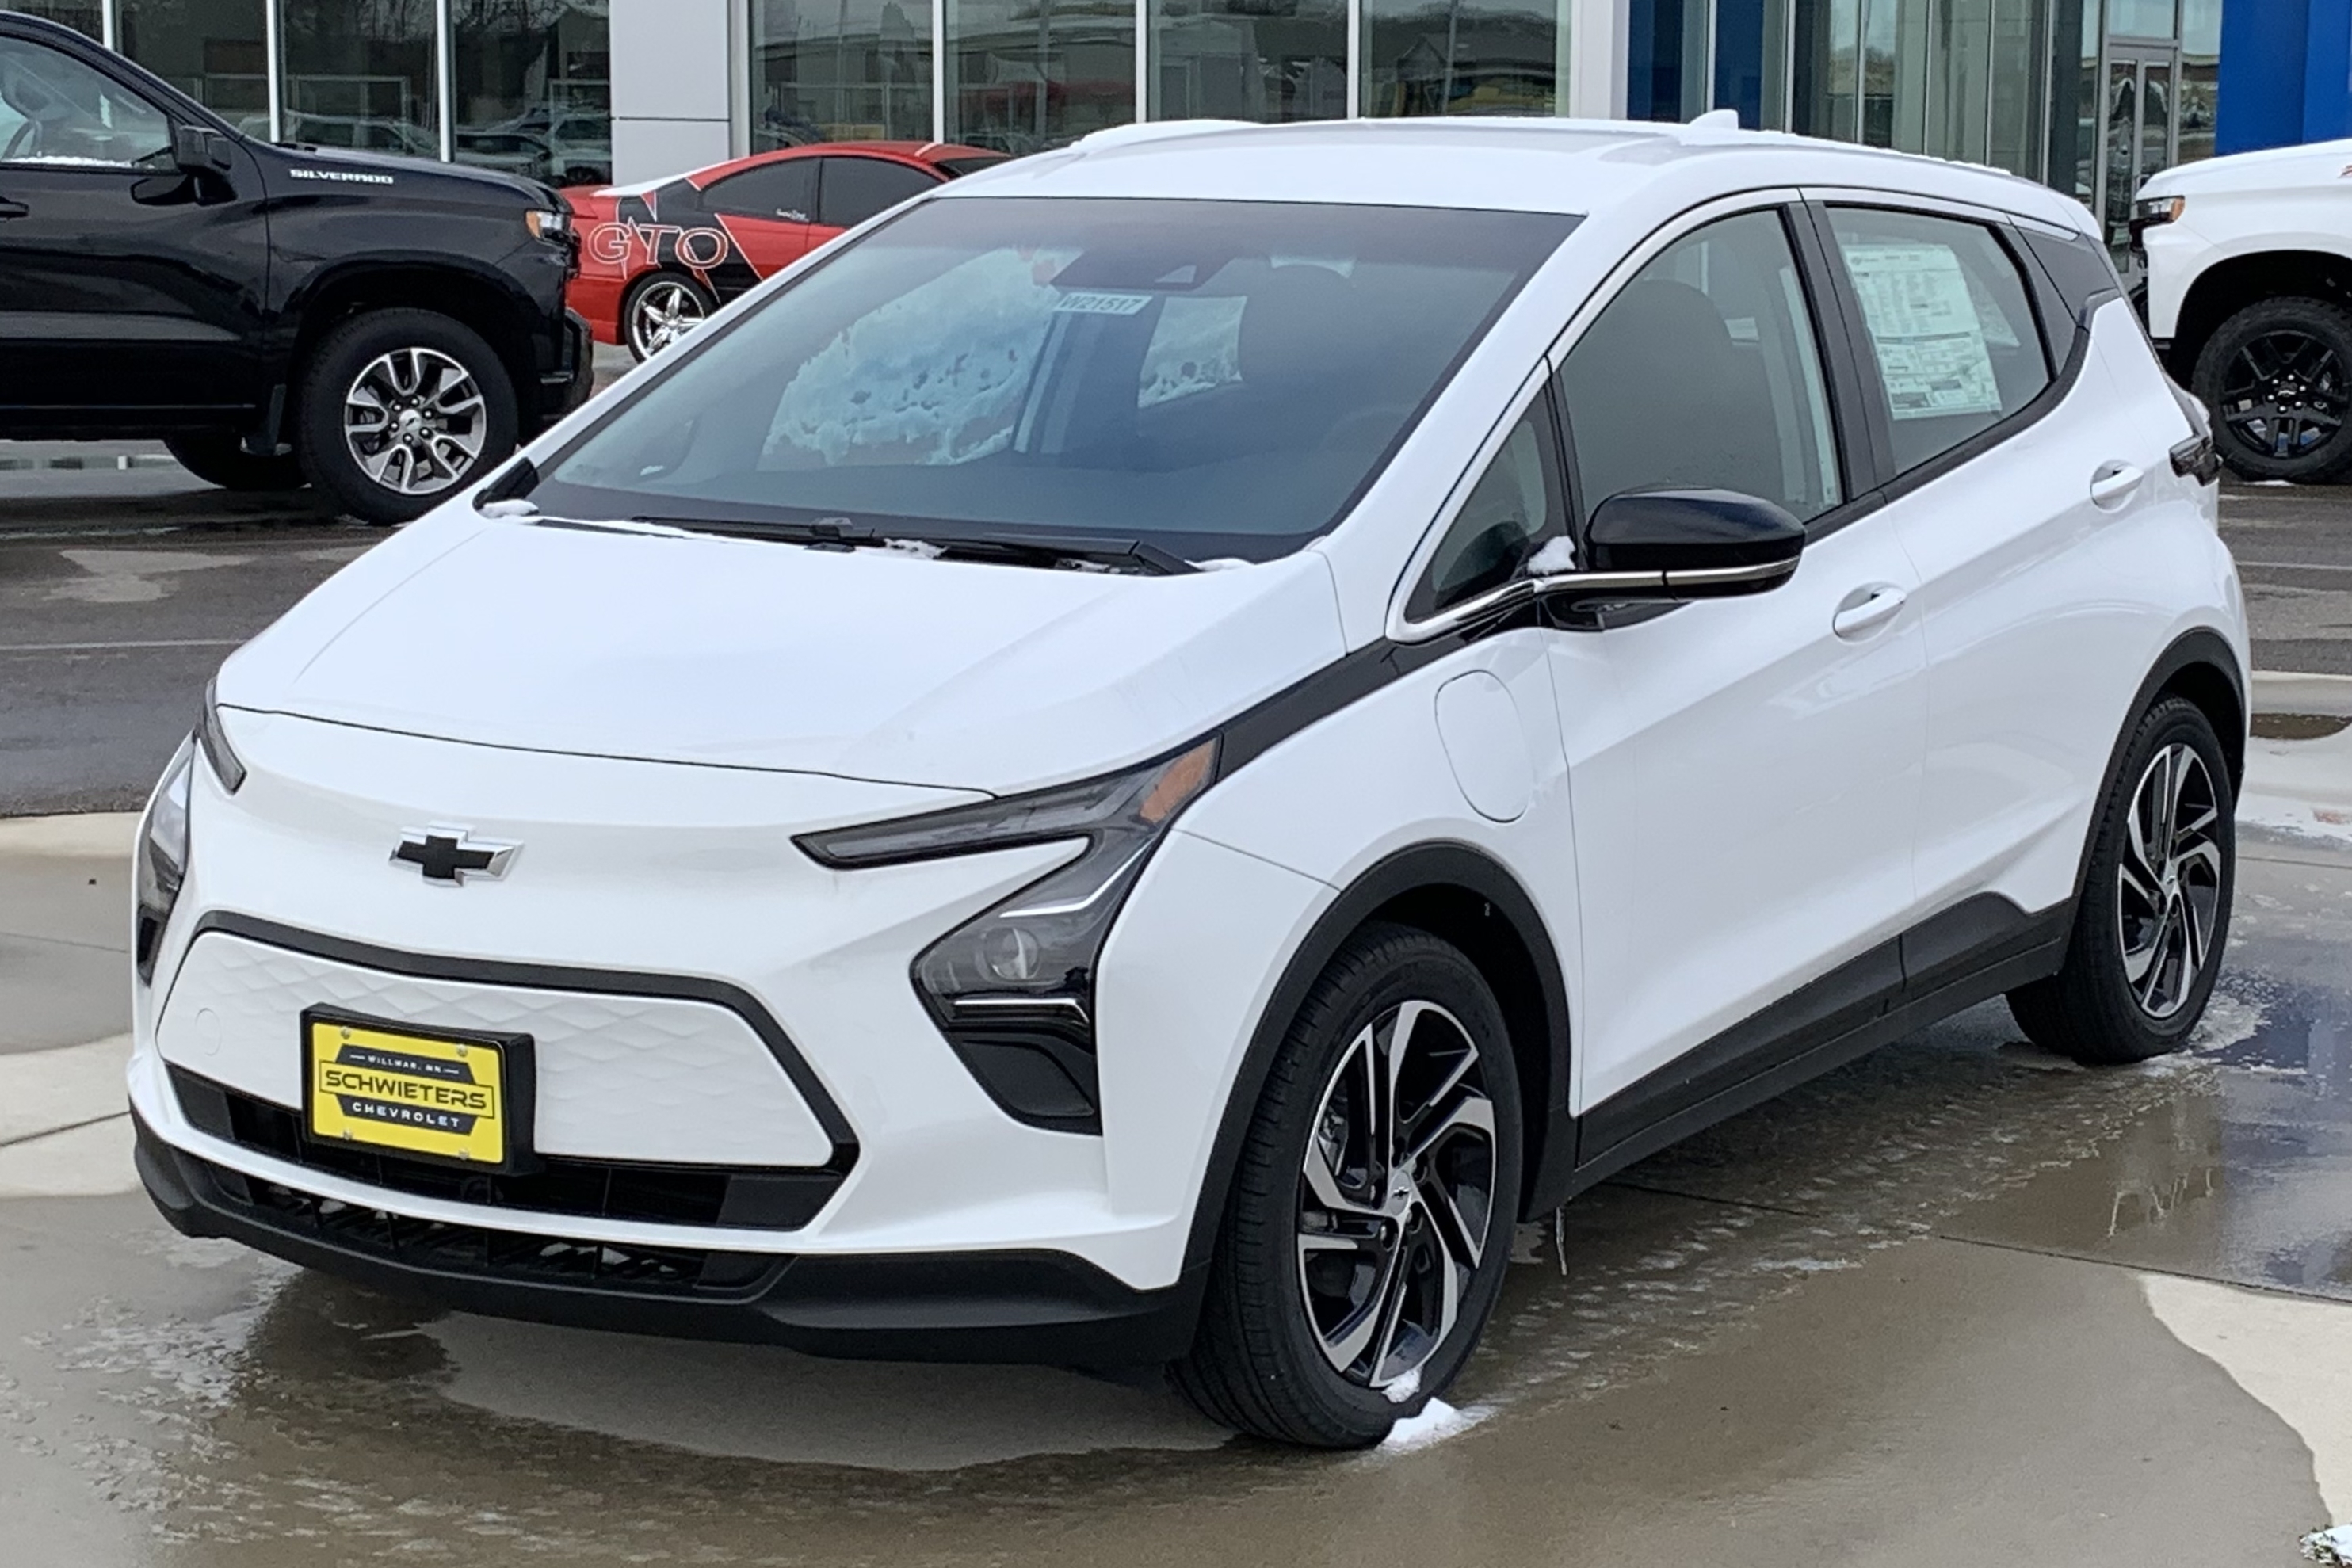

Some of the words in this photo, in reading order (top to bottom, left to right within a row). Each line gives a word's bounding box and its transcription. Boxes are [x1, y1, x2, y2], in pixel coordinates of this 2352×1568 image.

[289, 169, 394, 185] SILVERADO
[588, 222, 728, 269] GTO
[1059, 296, 1143, 312] W21517
[326, 1070, 486, 1109] SCHWIETERS
[353, 1101, 460, 1127] CHEVROLET
